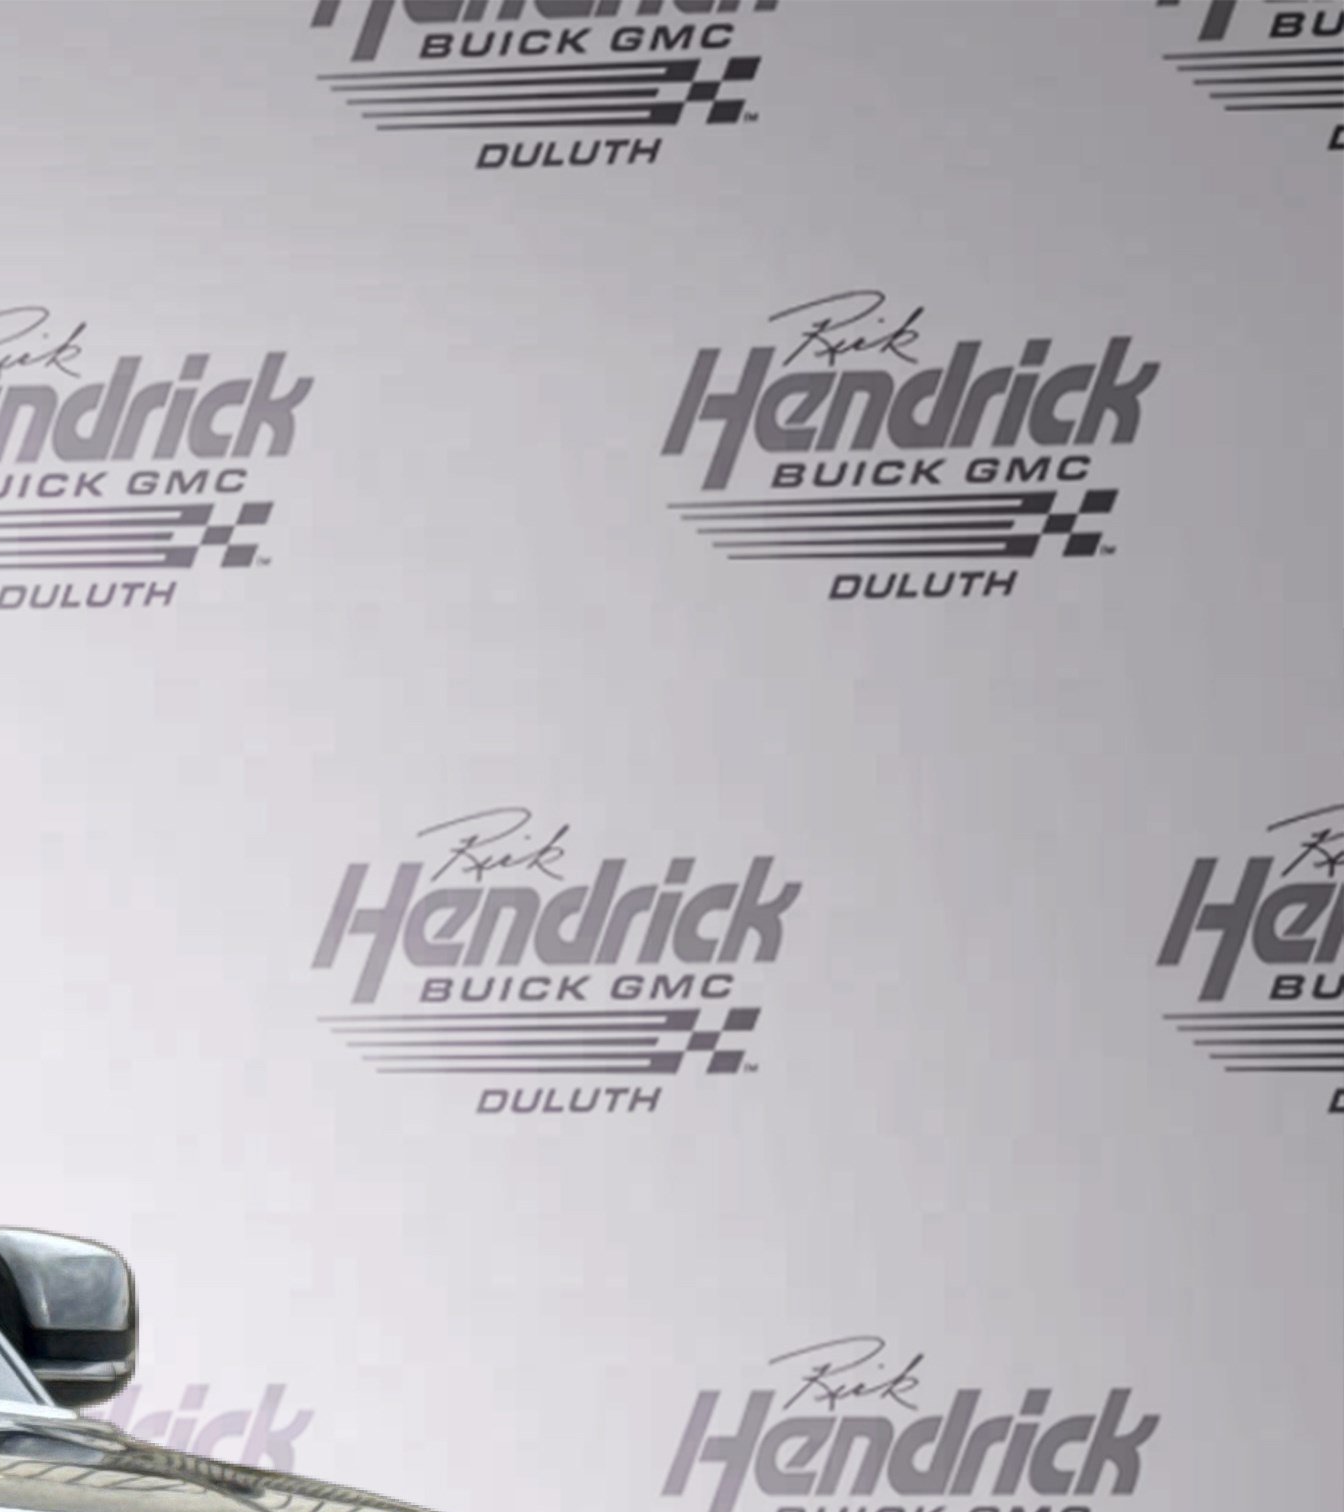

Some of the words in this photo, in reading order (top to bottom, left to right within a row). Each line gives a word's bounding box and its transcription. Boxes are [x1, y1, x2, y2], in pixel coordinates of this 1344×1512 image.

[418, 28, 589, 60] BUICK
[611, 22, 735, 52] GMC
[474, 137, 663, 170] DULUTH
[660, 335, 1161, 492] Hendrick
[126, 468, 248, 496] GMC
[770, 459, 945, 489] BUICK
[965, 454, 1092, 484] GMC
[827, 569, 1019, 601] DULUTH
[311, 855, 803, 1004] Hendrick
[419, 975, 590, 1003] BUICK
[611, 973, 735, 1000] GMC
[474, 1086, 663, 1114] DULUTH
